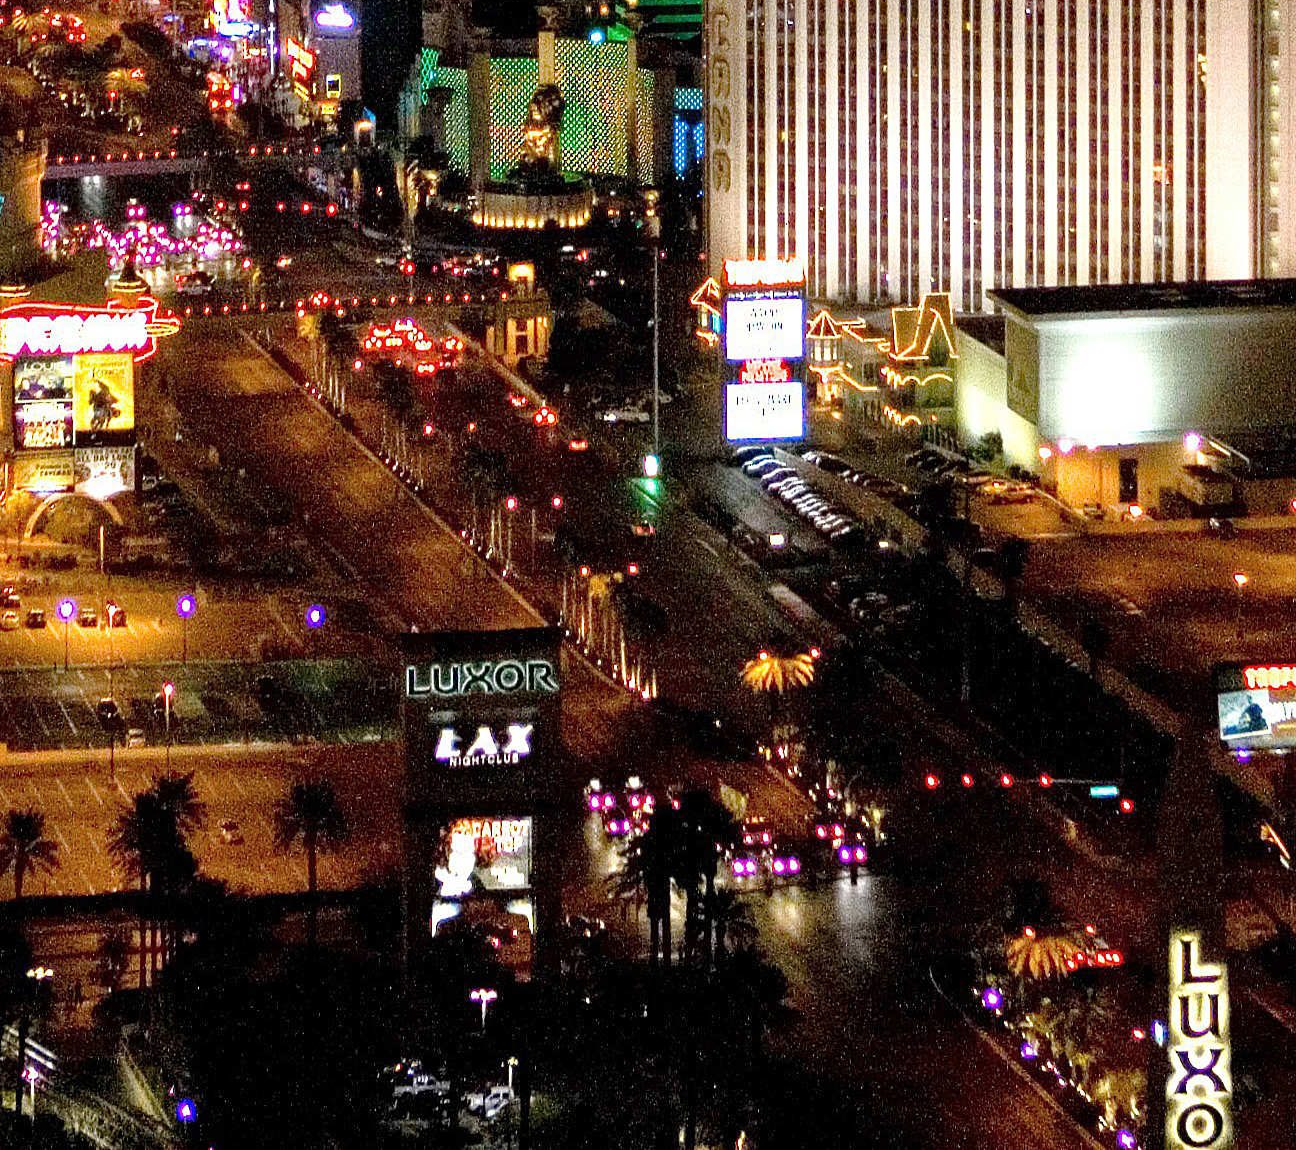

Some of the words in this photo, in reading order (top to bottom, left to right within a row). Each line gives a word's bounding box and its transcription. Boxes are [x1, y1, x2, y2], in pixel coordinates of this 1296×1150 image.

[406, 659, 561, 698] LUXOR
[435, 724, 534, 759] LAX
[449, 753, 520, 768] NIGHTCLUB
